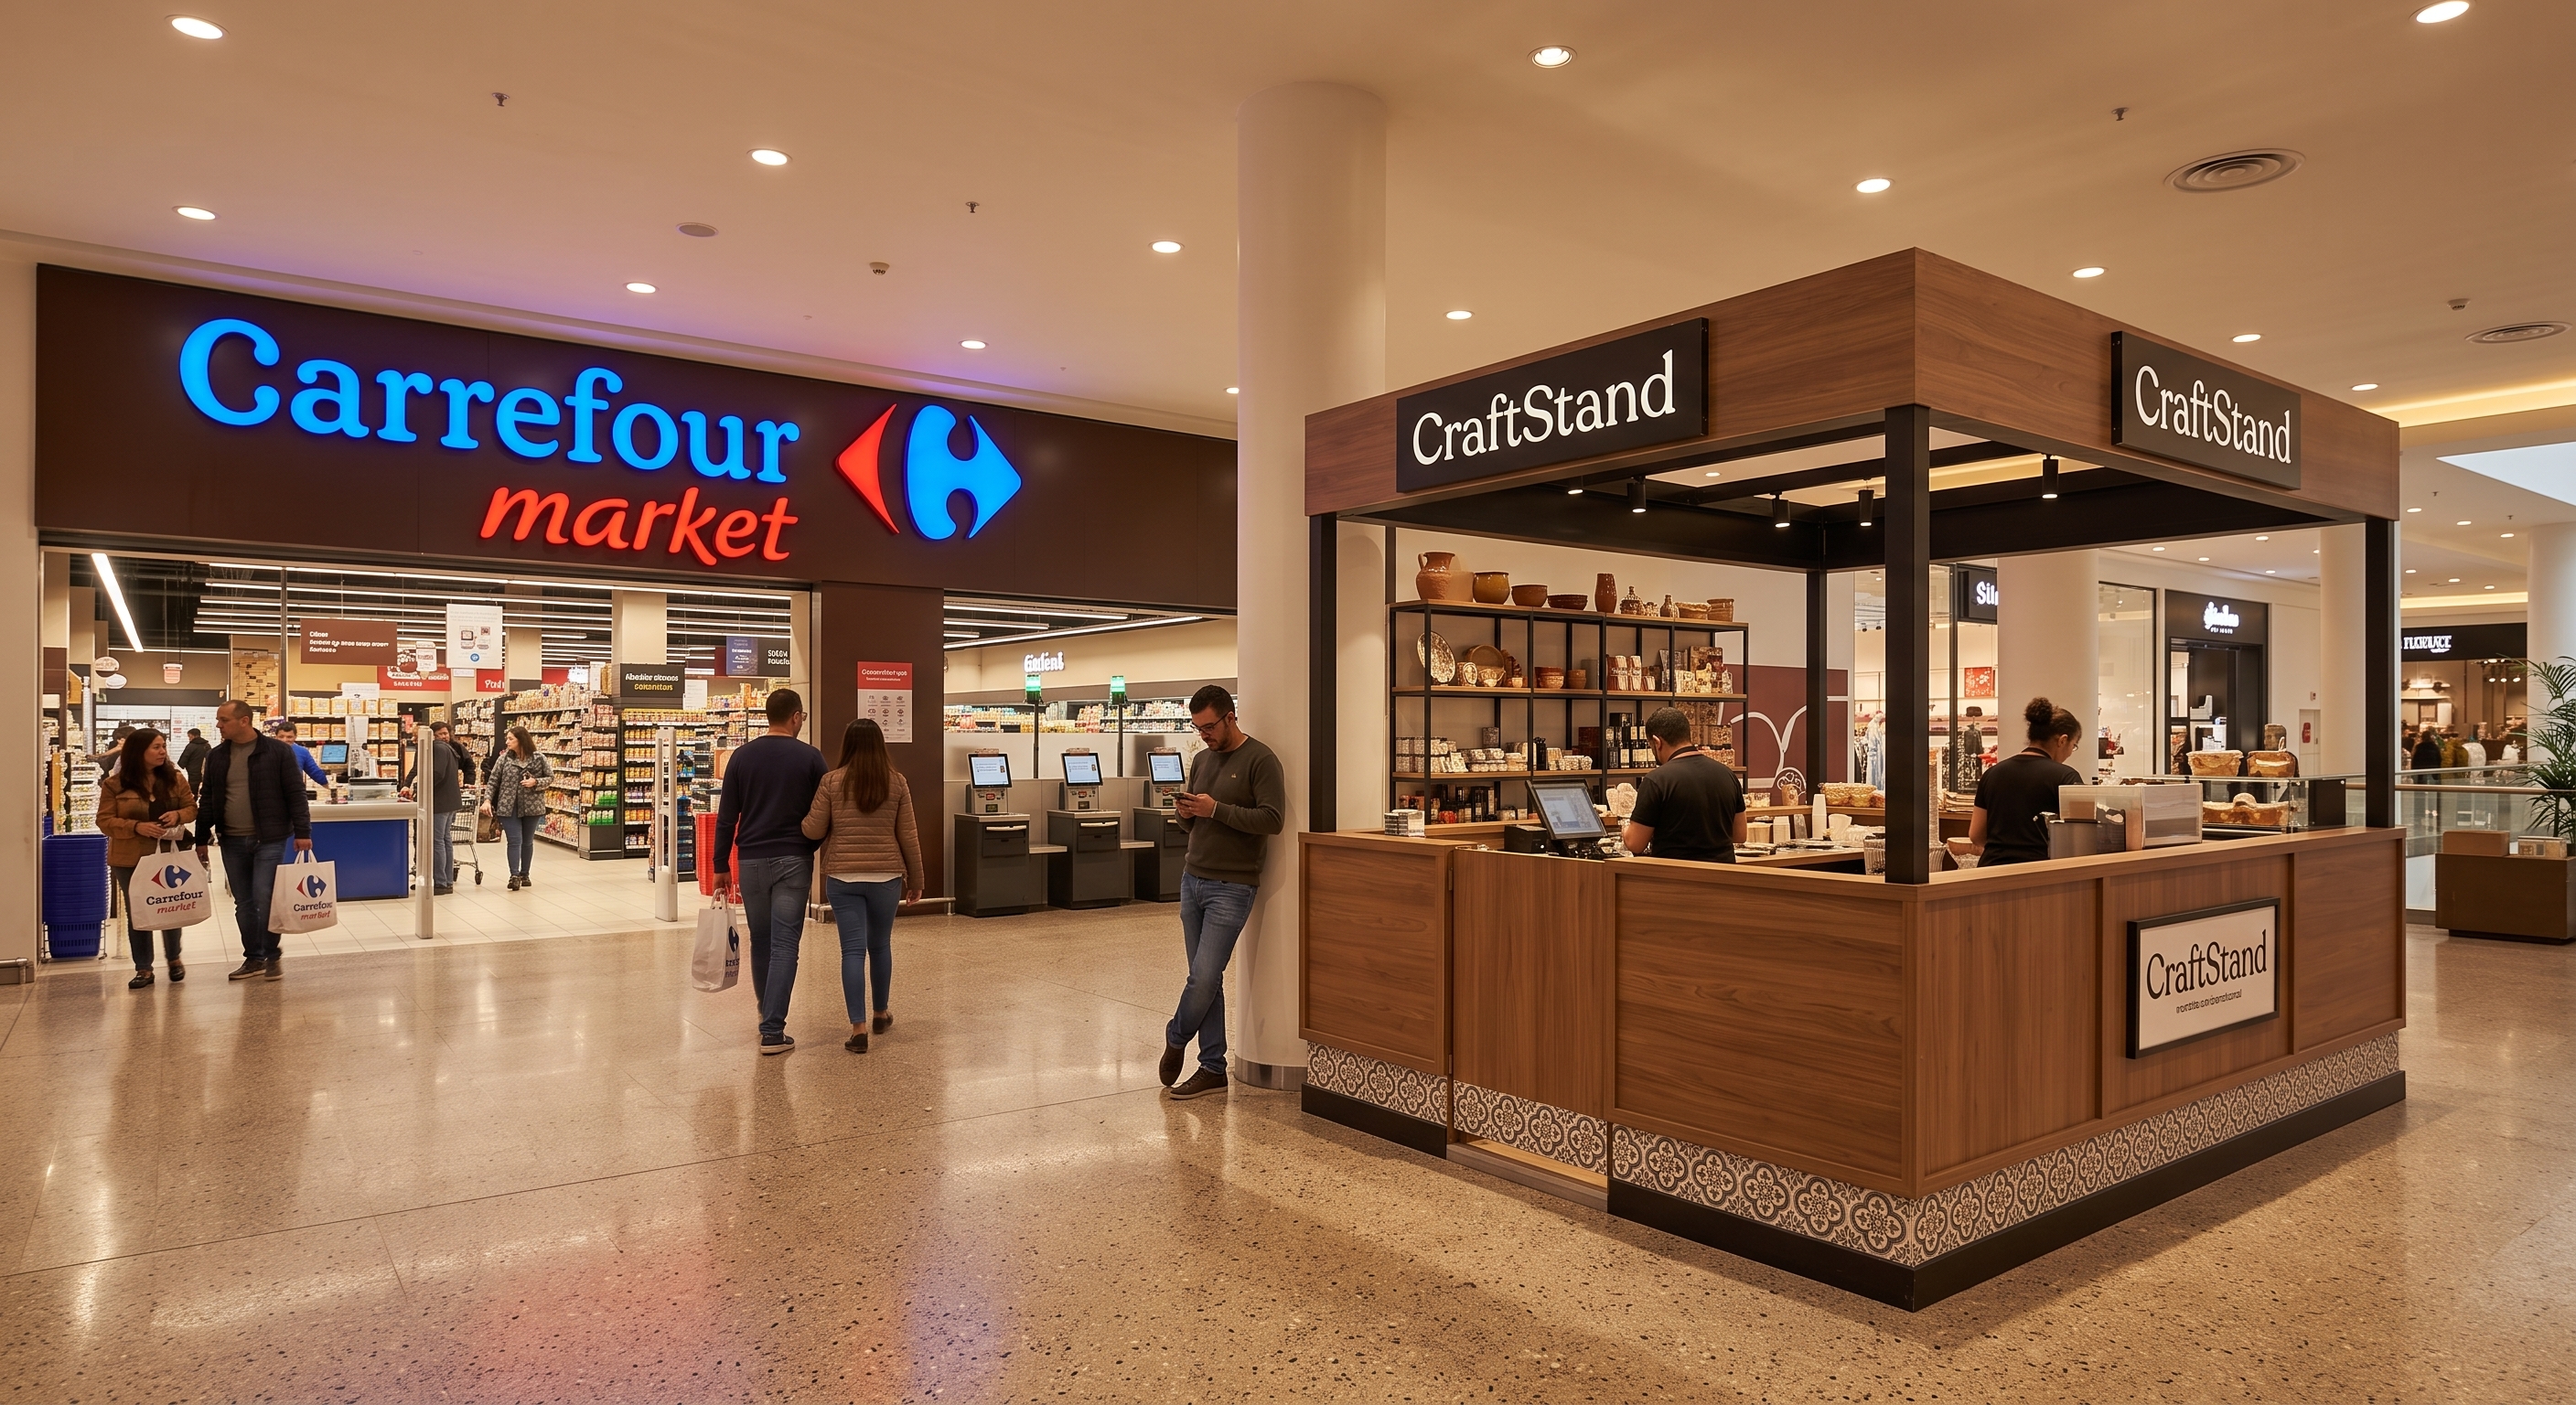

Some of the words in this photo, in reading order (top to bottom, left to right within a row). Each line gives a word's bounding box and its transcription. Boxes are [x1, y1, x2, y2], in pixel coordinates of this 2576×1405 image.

[179, 318, 800, 484] Carrefour
[1412, 349, 1676, 466] CraftStand
[2135, 365, 2292, 464] CraftStand
[480, 487, 799, 566] market
[146, 890, 204, 906] Carrefour
[2146, 928, 2268, 1000] CraftStand
